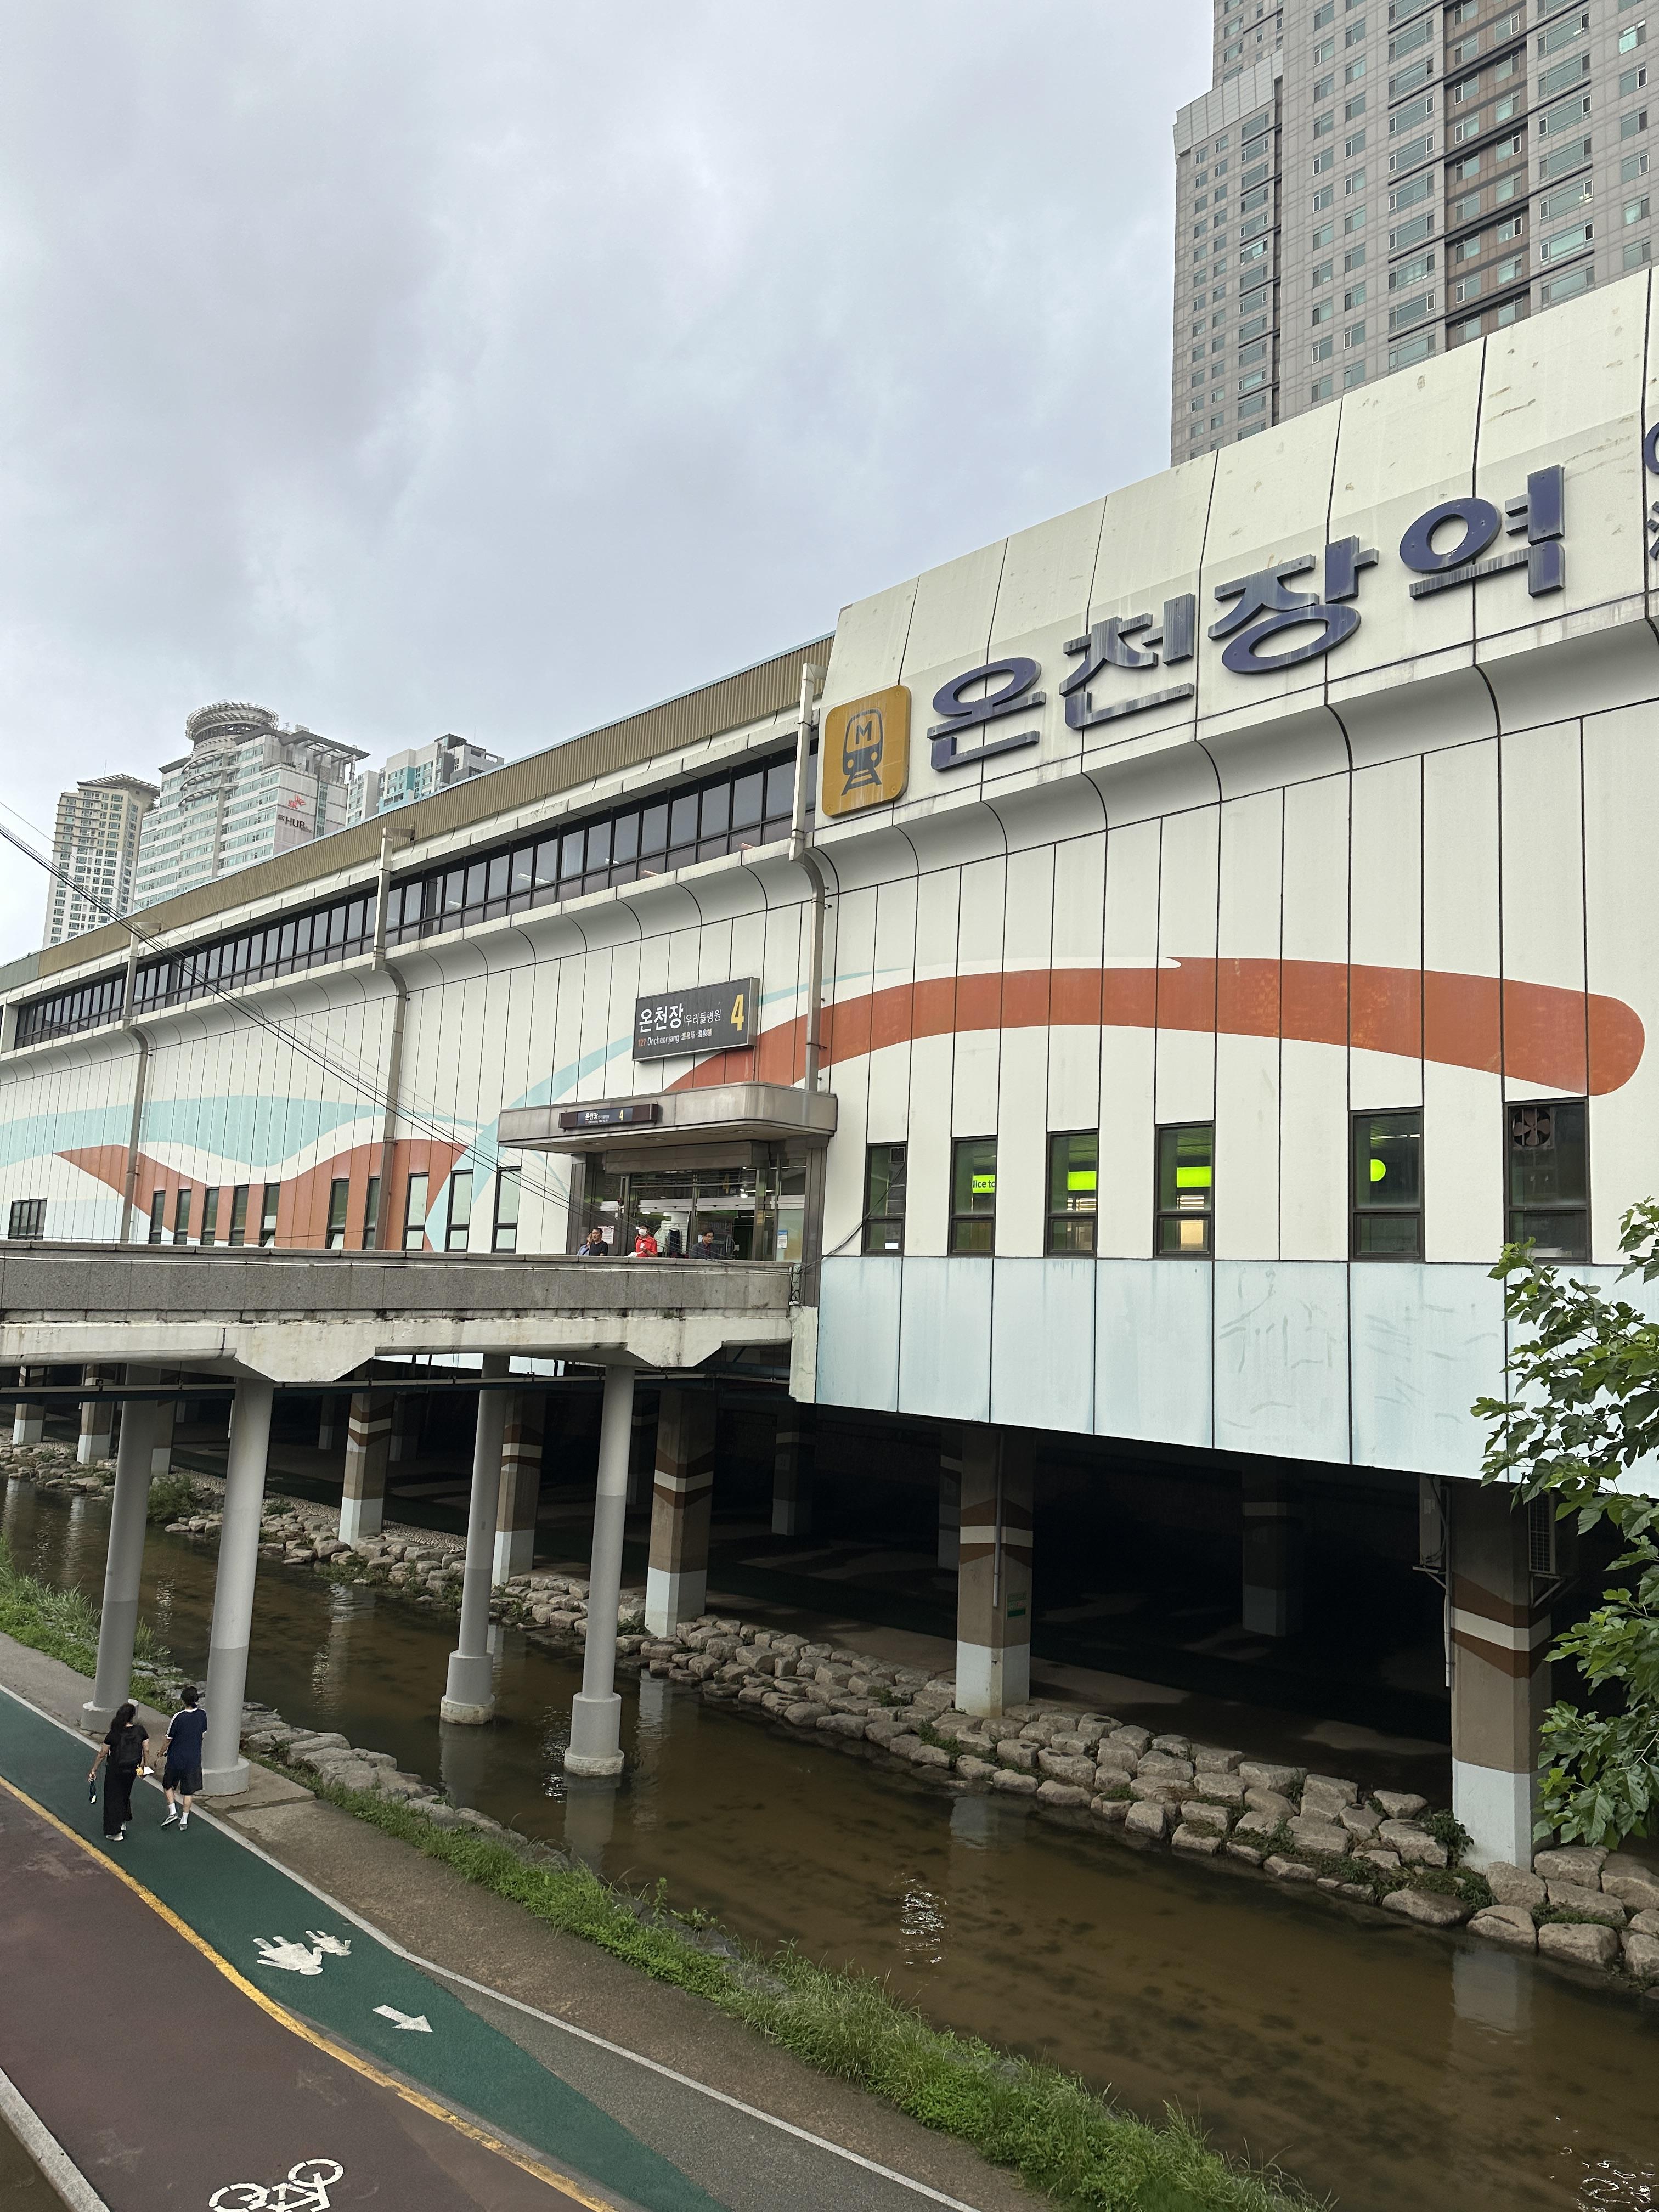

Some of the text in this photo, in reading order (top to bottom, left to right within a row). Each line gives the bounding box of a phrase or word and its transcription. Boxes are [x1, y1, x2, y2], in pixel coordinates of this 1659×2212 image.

[927, 464, 1565, 772] 온천장역
[855, 720, 872, 745] M
[285, 816, 305, 828] HUB
[639, 1003, 721, 1033] 온천장 우리들병원
[731, 994, 744, 1031] 4
[638, 1038, 646, 1047] 127
[619, 1109, 624, 1121] 4
